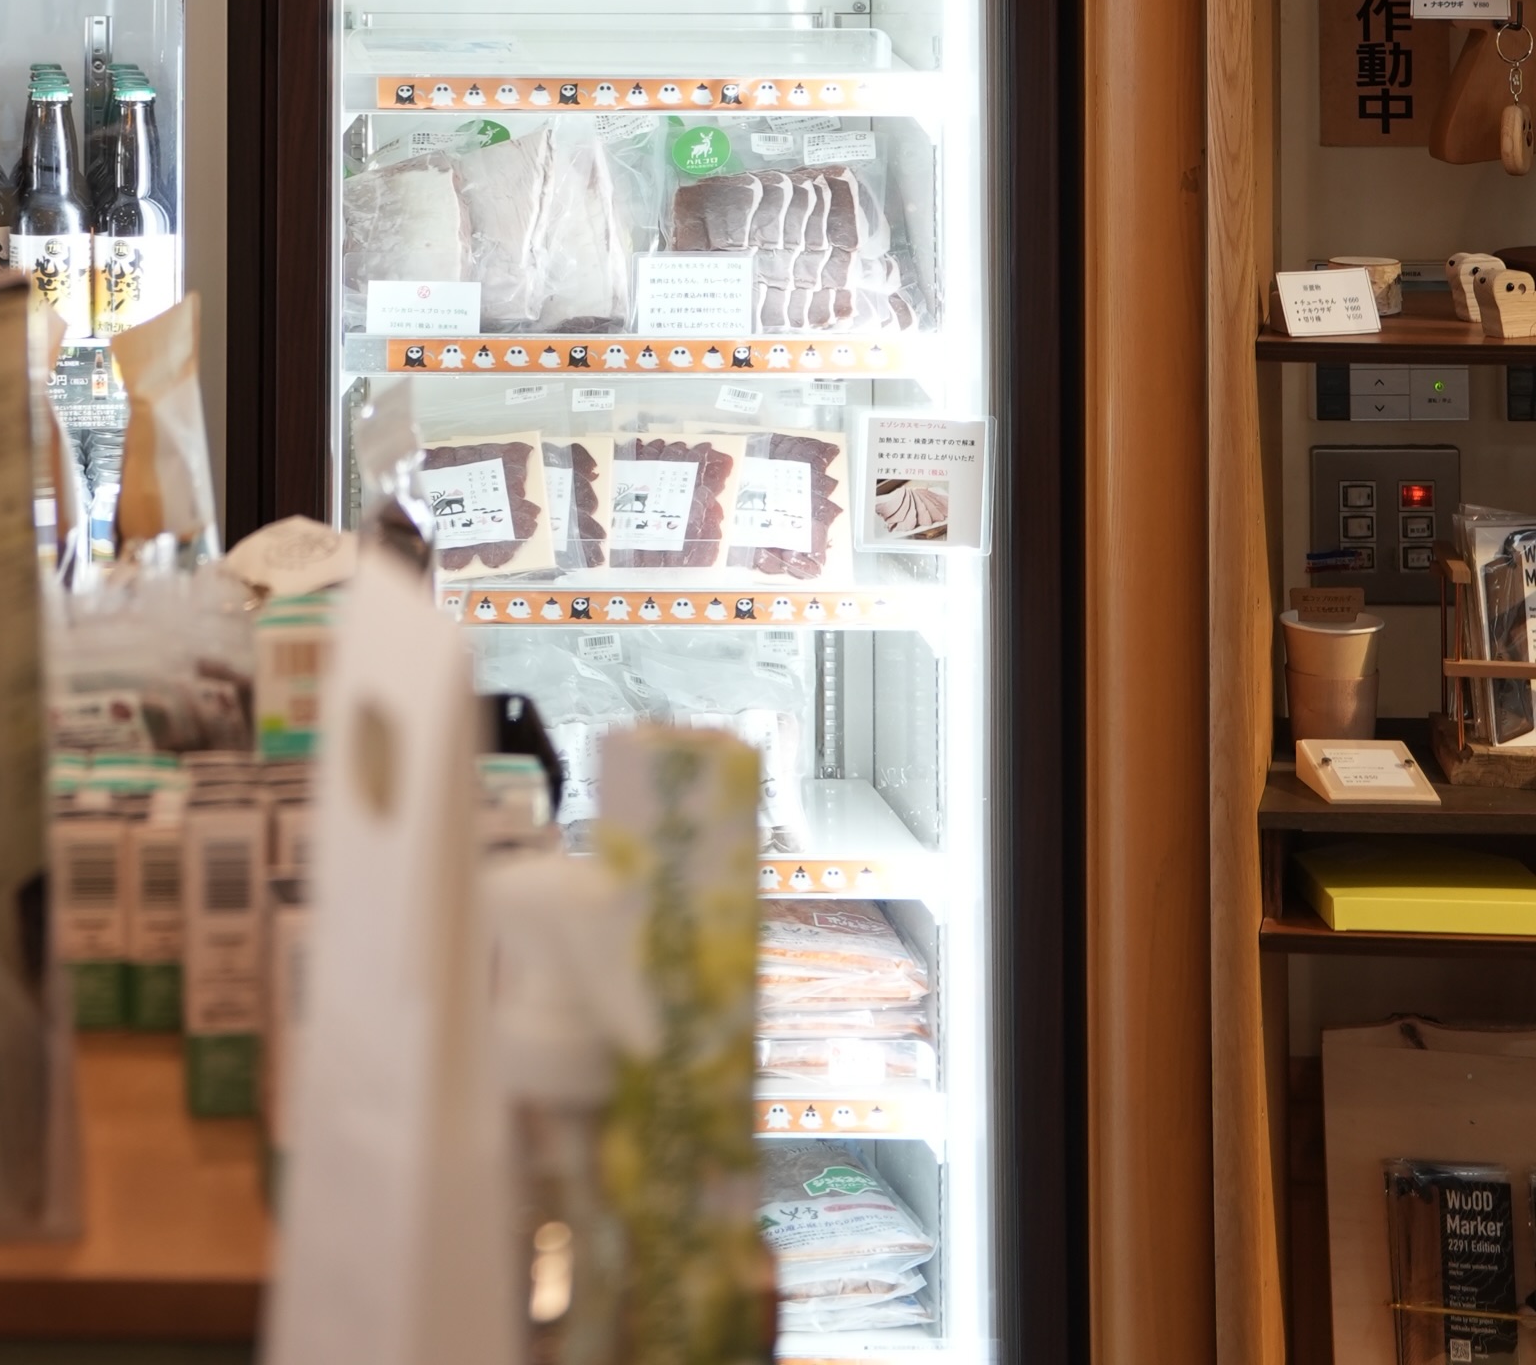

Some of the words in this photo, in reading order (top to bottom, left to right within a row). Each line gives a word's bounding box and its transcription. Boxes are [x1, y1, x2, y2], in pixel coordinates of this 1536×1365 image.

[1430, 1, 1464, 9] ナキウサギ
[879, 421, 946, 429] エゾシカスモークハム
[1445, 1213, 1503, 1237] Marker
[1448, 1238, 1469, 1252] 2291
[1471, 1239, 1501, 1254] Edition
